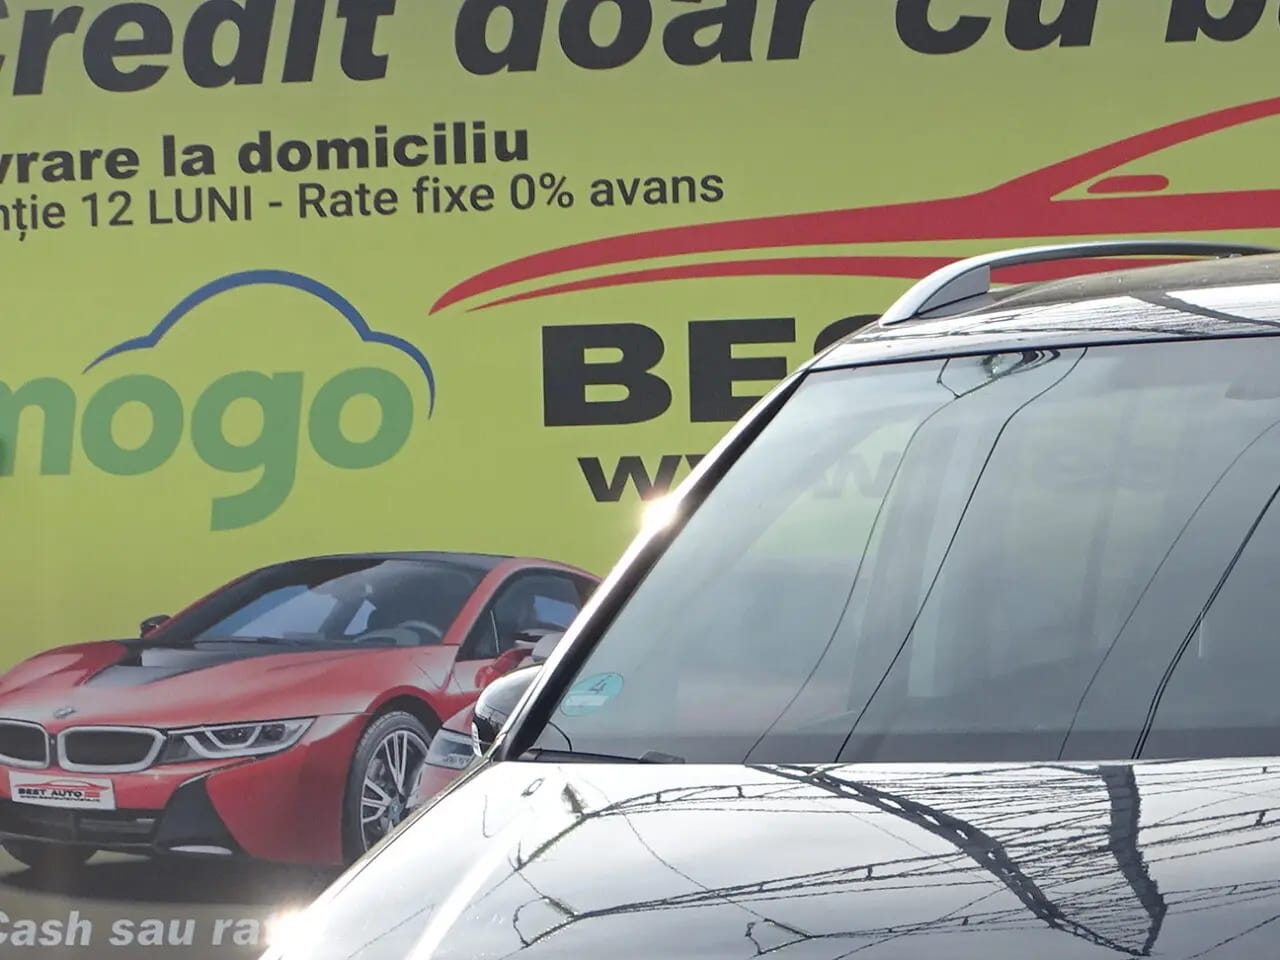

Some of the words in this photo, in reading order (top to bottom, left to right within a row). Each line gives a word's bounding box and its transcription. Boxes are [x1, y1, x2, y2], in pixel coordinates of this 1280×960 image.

[0, 0, 396, 96] redit
[163, 135, 215, 177] la
[238, 121, 528, 174] domiciliu
[81, 191, 133, 227] 12
[149, 186, 252, 224] LUNI
[298, 182, 398, 218] Rate
[413, 175, 494, 214] fixe
[510, 172, 574, 209] 0%
[590, 173, 724, 207] avans
[542, 314, 882, 427] BE
[109, 919, 195, 946] sau
[212, 919, 272, 946] ra
